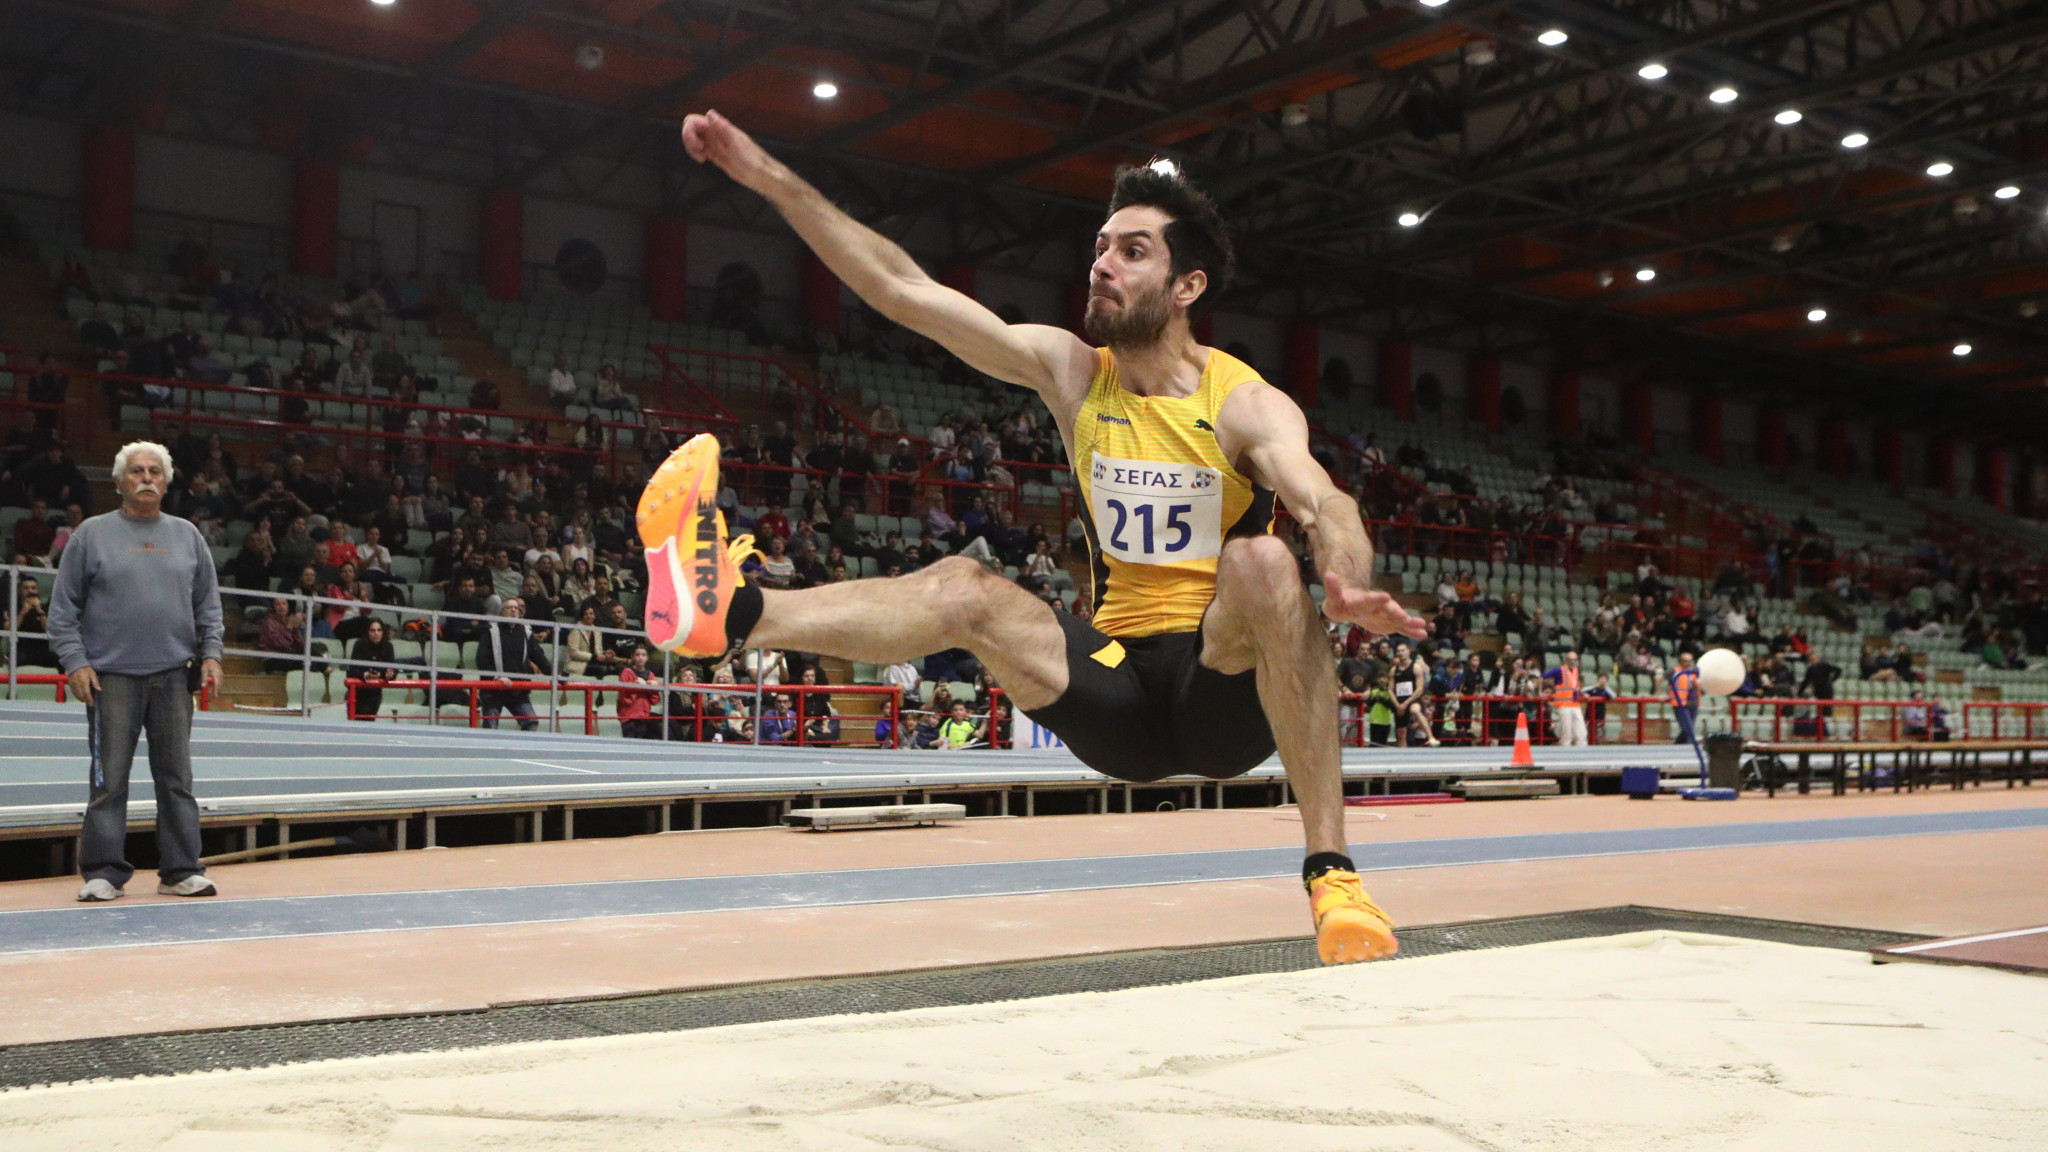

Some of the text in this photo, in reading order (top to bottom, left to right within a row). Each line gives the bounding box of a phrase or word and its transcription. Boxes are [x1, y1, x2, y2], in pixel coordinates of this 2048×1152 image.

[1114, 468, 1182, 488] ΣΕΓΑΣ
[1106, 498, 1192, 554] 215
[695, 497, 718, 614] NITRO
